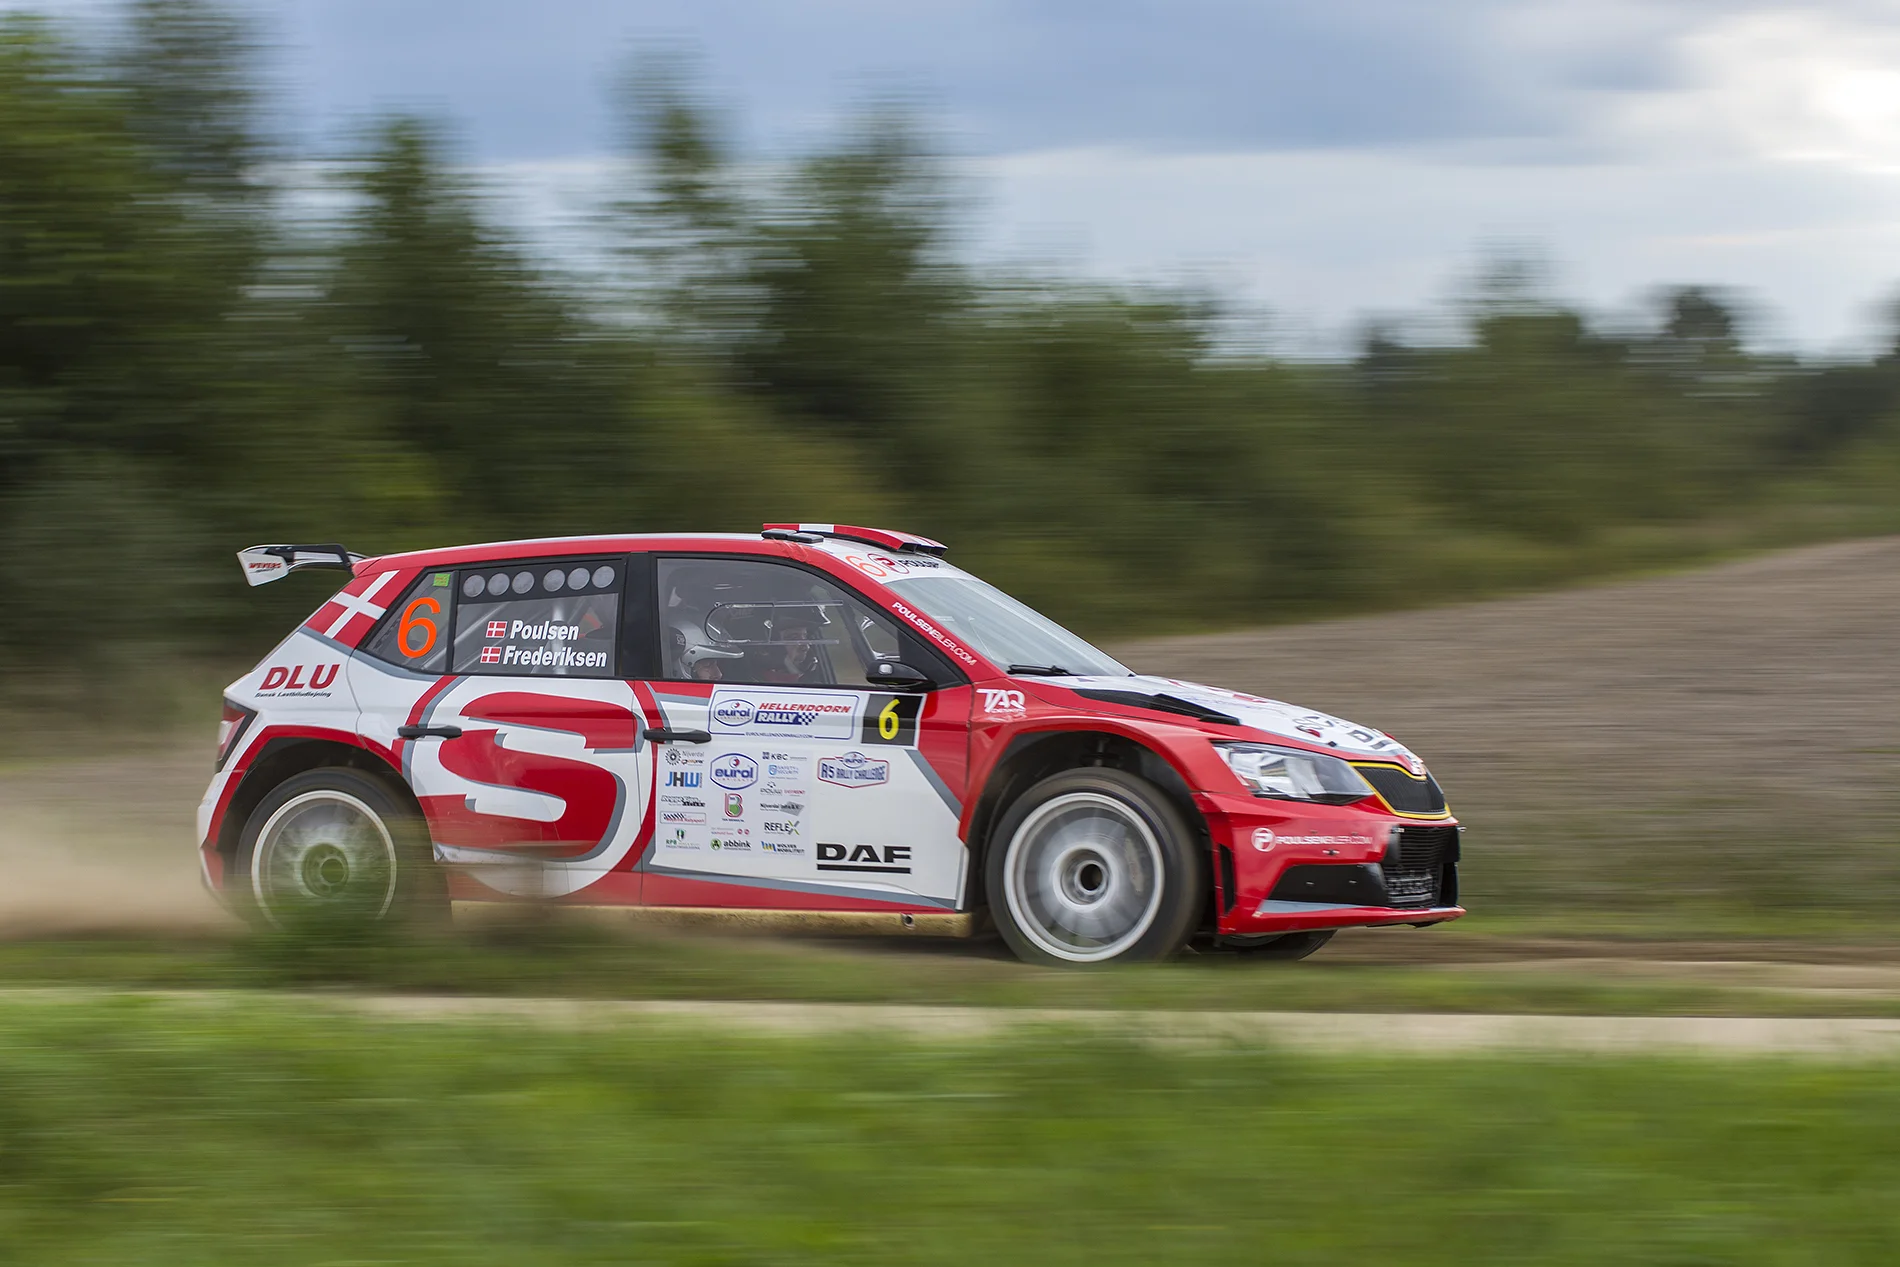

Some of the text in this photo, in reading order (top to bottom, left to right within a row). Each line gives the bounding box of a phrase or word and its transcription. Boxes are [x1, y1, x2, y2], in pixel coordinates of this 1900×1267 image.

[397, 597, 441, 659] 6
[509, 620, 579, 641] Poulsen
[502, 645, 607, 668] Frederiksen
[258, 663, 341, 691] DLU
[717, 707, 750, 717] eurol
[758, 702, 852, 713] HELLENDOORN
[756, 711, 798, 723] RALLY
[878, 698, 901, 740] 6
[664, 771, 700, 788] JHW
[714, 767, 754, 779] eurol
[764, 820, 800, 836] REFLEX
[723, 840, 751, 848] abbink
[816, 842, 912, 864] DAF
